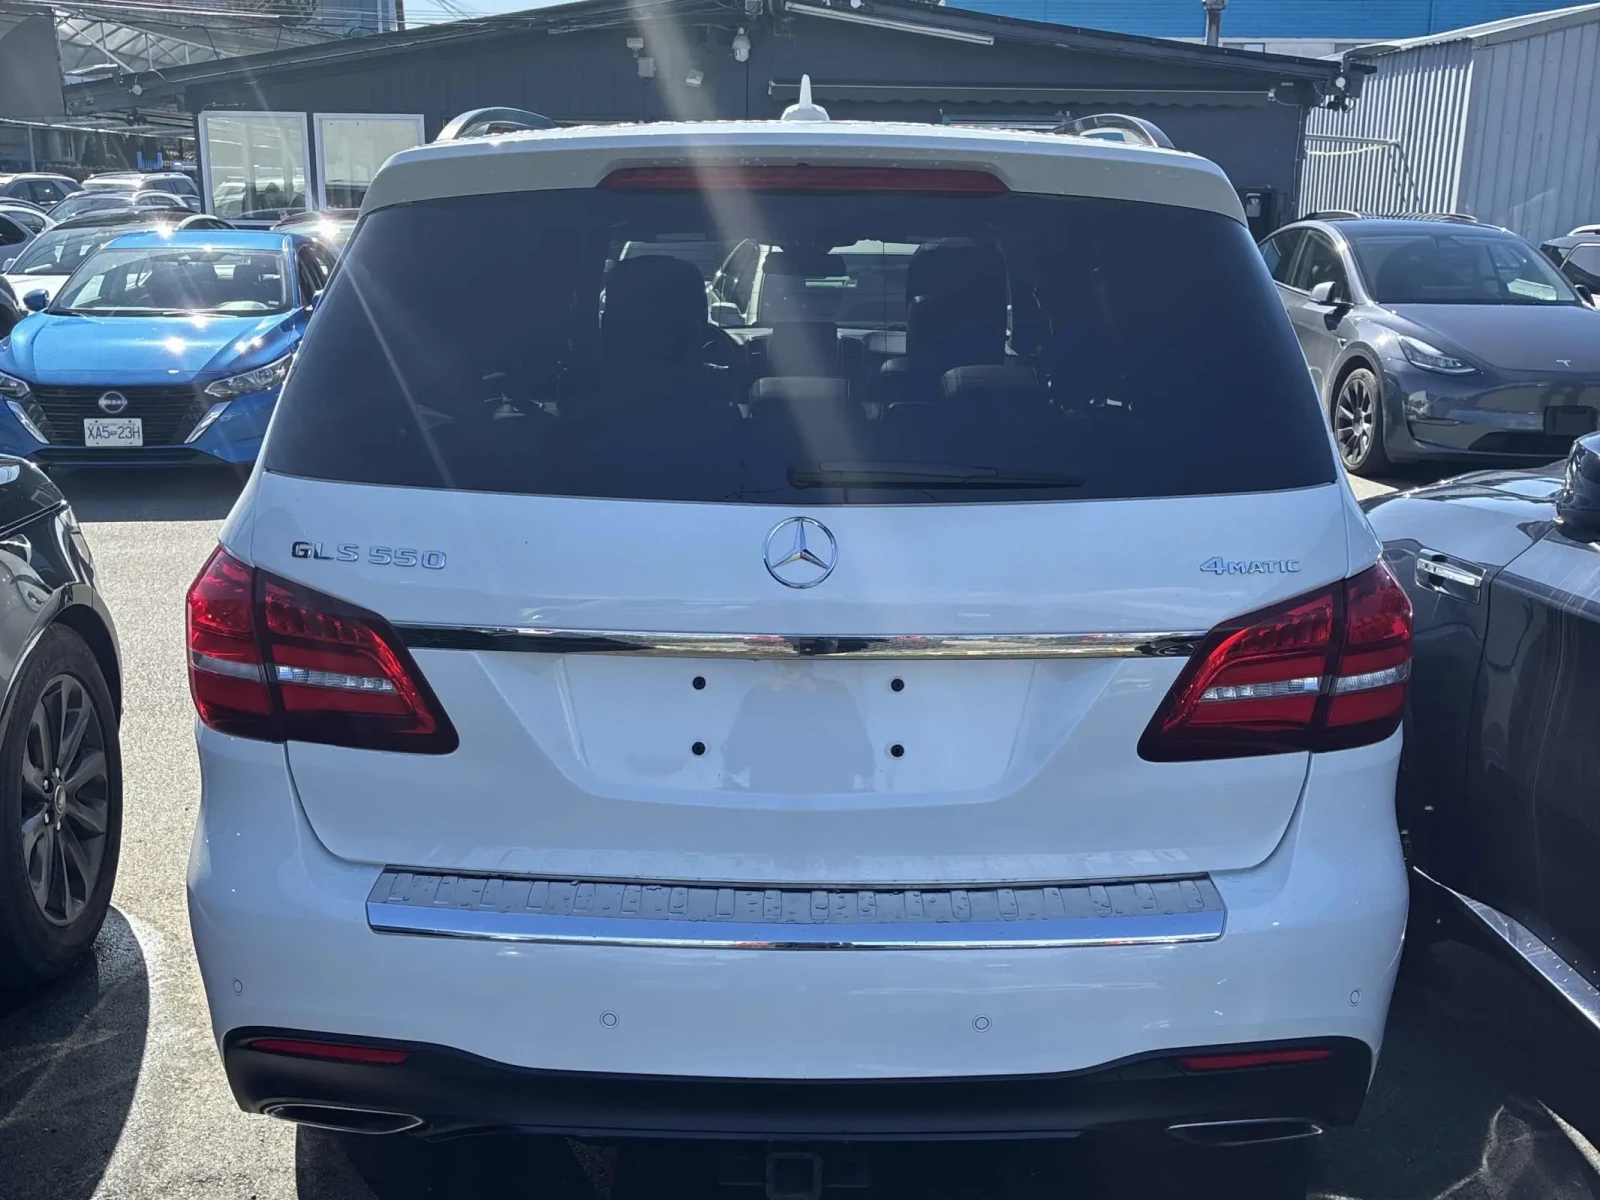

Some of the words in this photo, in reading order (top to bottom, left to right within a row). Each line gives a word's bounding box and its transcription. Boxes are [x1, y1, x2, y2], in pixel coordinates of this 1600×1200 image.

[291, 541, 359, 562] GLS
[368, 546, 447, 570] 550
[1200, 556, 1301, 576] 4MATIC
